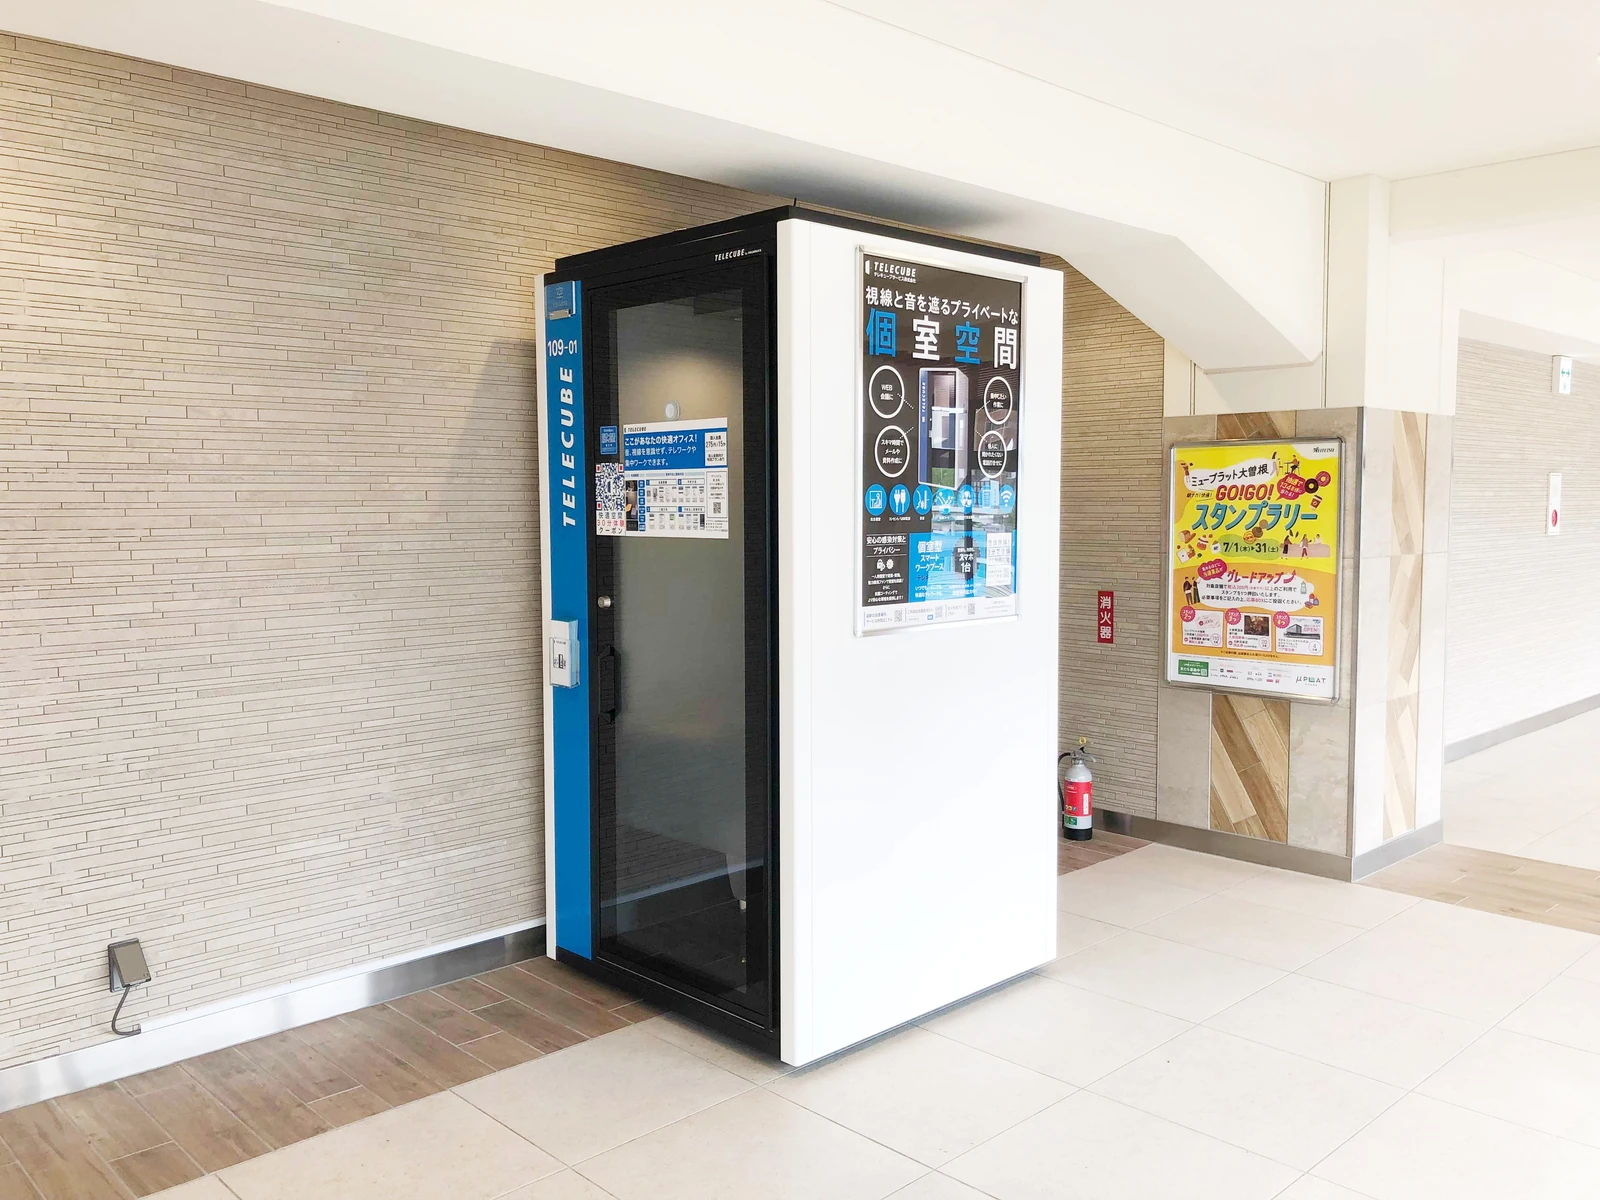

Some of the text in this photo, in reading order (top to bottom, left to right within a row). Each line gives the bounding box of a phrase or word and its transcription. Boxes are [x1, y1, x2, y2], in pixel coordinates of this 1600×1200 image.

[714, 248, 745, 262] TELECUBE
[873, 261, 917, 277] TELECUBE
[865, 285, 1019, 325] 視線と音を遮るプライベートな
[865, 307, 1018, 370] 個室空間
[547, 339, 578, 357] 109-01
[559, 367, 577, 527] TELECUBE
[1191, 463, 1269, 487] ミュープラット大曽根
[1215, 483, 1275, 501] GO!GO!
[1191, 500, 1318, 531] スタンプラリー
[873, 546, 900, 555] プライバシー
[918, 540, 942, 554] 個室型
[920, 553, 940, 563] スマート
[959, 553, 974, 562] スマホ
[915, 563, 944, 572] ワークブース
[1227, 569, 1285, 584] グレードアップ
[1100, 596, 1112, 639] 消火器
